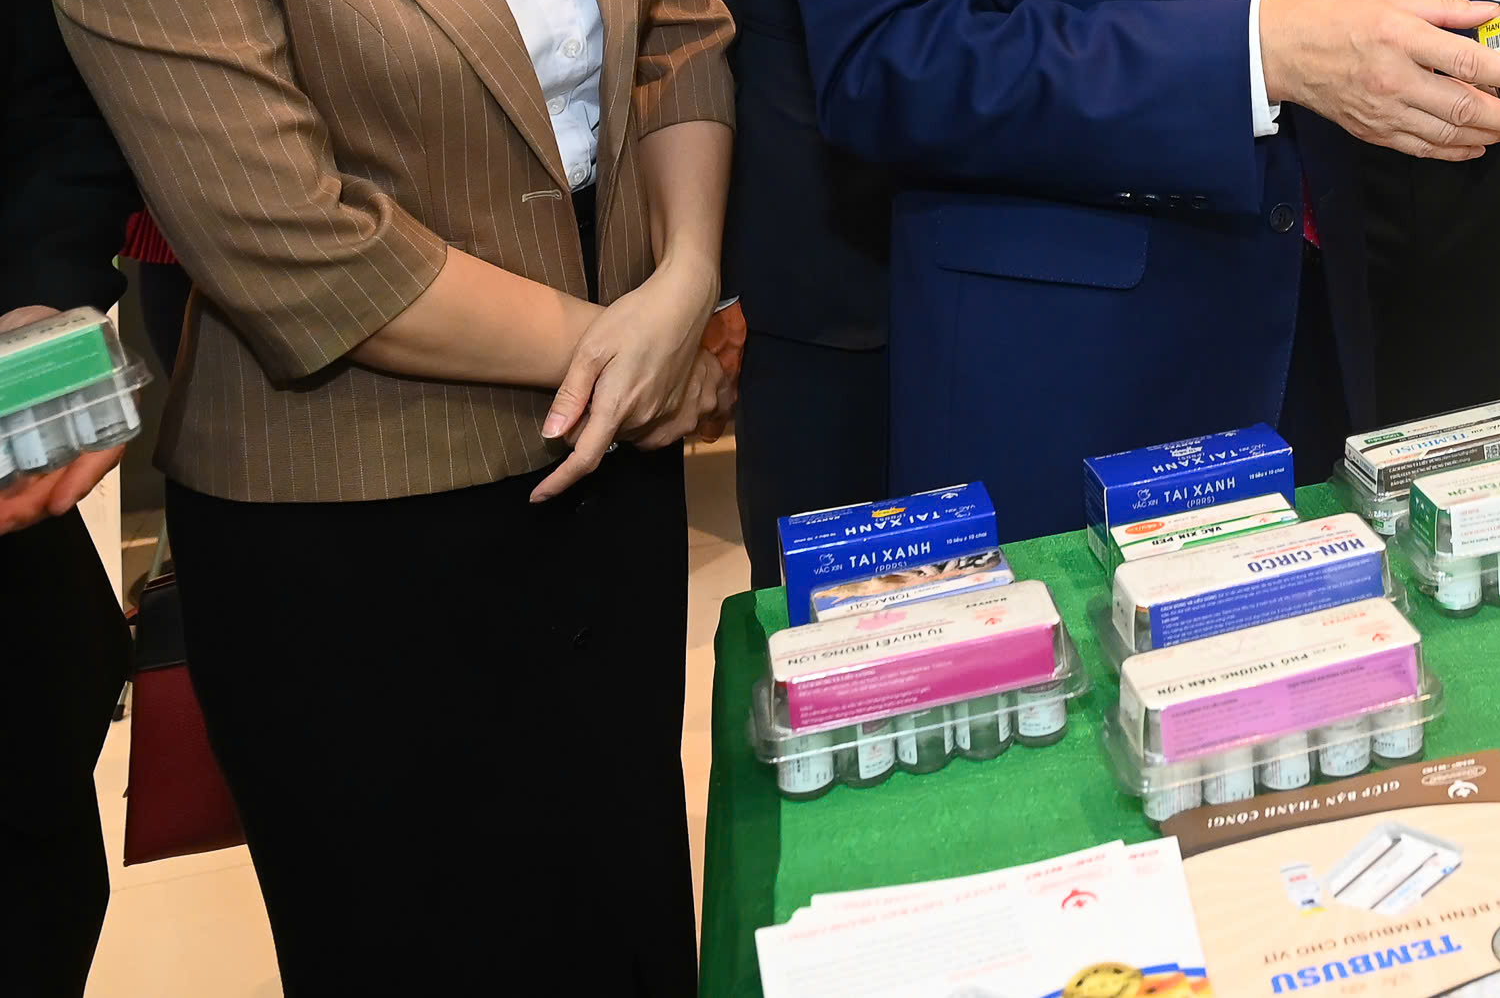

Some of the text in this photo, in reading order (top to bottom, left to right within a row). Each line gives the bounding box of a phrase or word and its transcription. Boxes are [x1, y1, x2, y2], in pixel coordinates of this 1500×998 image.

[1388, 432, 1470, 456] TEMBUSU
[1152, 450, 1240, 475] TAI XANH
[1163, 487, 1189, 503] TAI
[1193, 477, 1236, 497] XANH
[1186, 496, 1216, 509] (PRRS)
[845, 518, 902, 537] XANH
[909, 510, 941, 524] TAI
[1178, 530, 1196, 541] XIN
[813, 563, 831, 575] VẮC
[831, 562, 843, 572] XIN
[849, 552, 876, 569] TAI
[882, 542, 932, 561] XANH
[1247, 538, 1366, 574] HAN-CIRCO
[875, 630, 924, 648] HUYẾT
[927, 626, 944, 637] TỤ
[1207, 780, 1401, 829] GIÚP BẠN THÀNH CÔNG!
[1342, 913, 1432, 950] TEMBUSU
[1271, 934, 1463, 995] TEMBUSU
